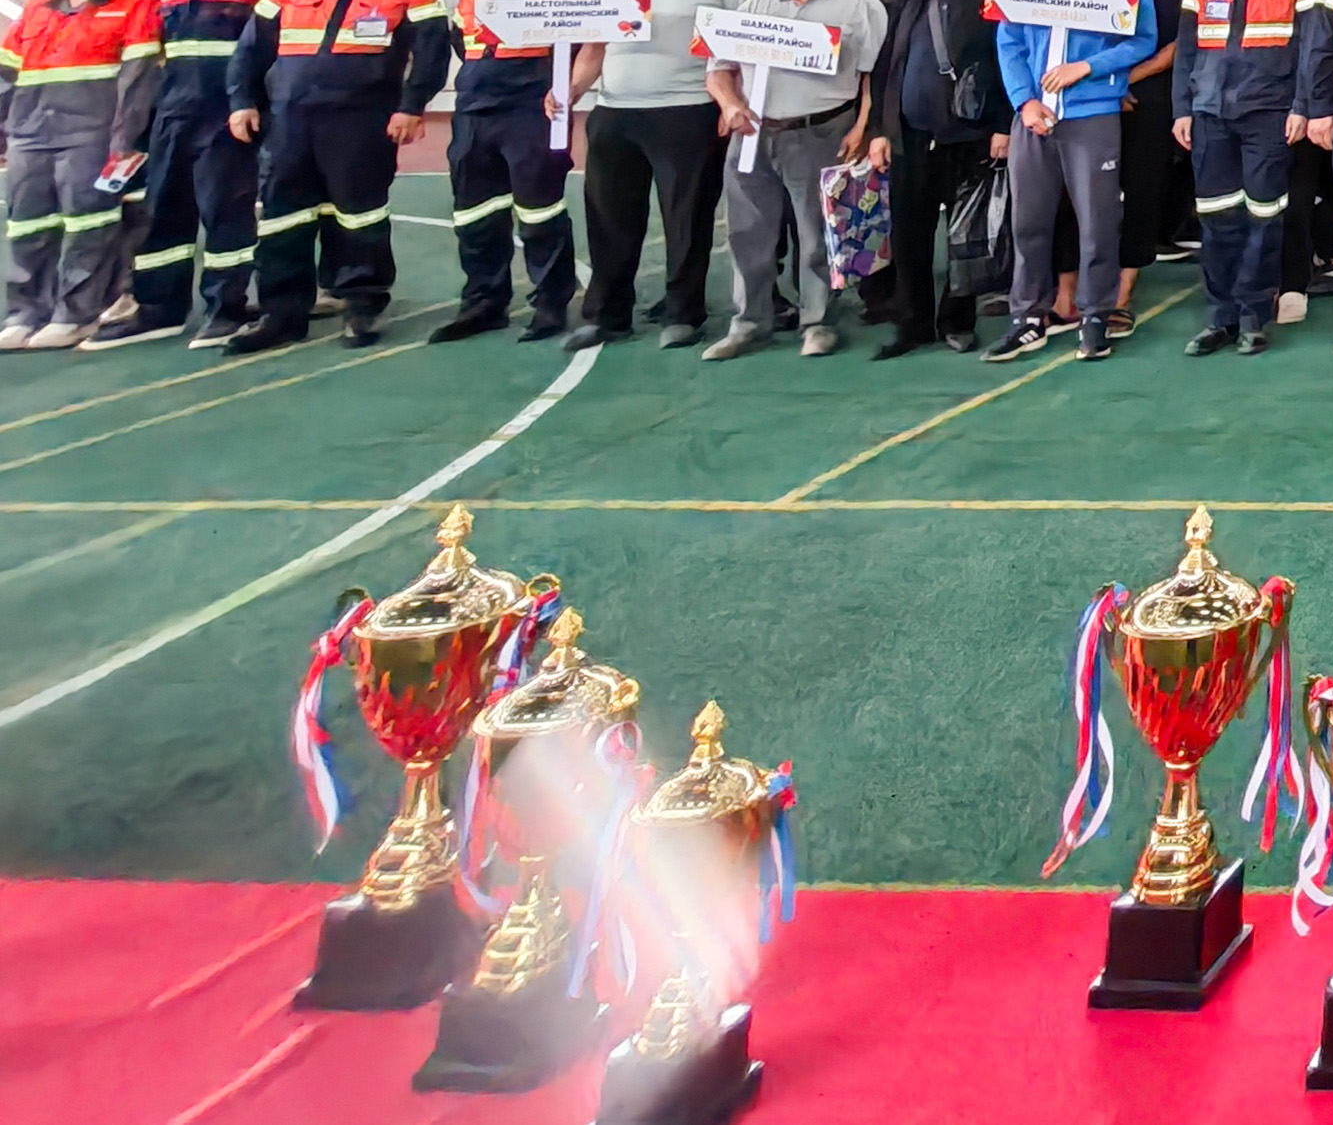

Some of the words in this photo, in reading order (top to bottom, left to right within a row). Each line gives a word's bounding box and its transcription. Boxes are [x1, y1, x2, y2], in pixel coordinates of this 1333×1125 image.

[525, 0, 601, 8] НАСТОЛЬНЫЙ
[1073, 0, 1109, 11] РАЙОН
[507, 11, 549, 19] ТЕННИС
[552, 9, 619, 18] КЕМИНСКИЙ
[543, 20, 582, 28] РАЙОН
[741, 19, 794, 33] ШАХМАТЫ
[715, 28, 775, 44] КЕМИНСКИЙ
[778, 36, 813, 49] РАЙОН
